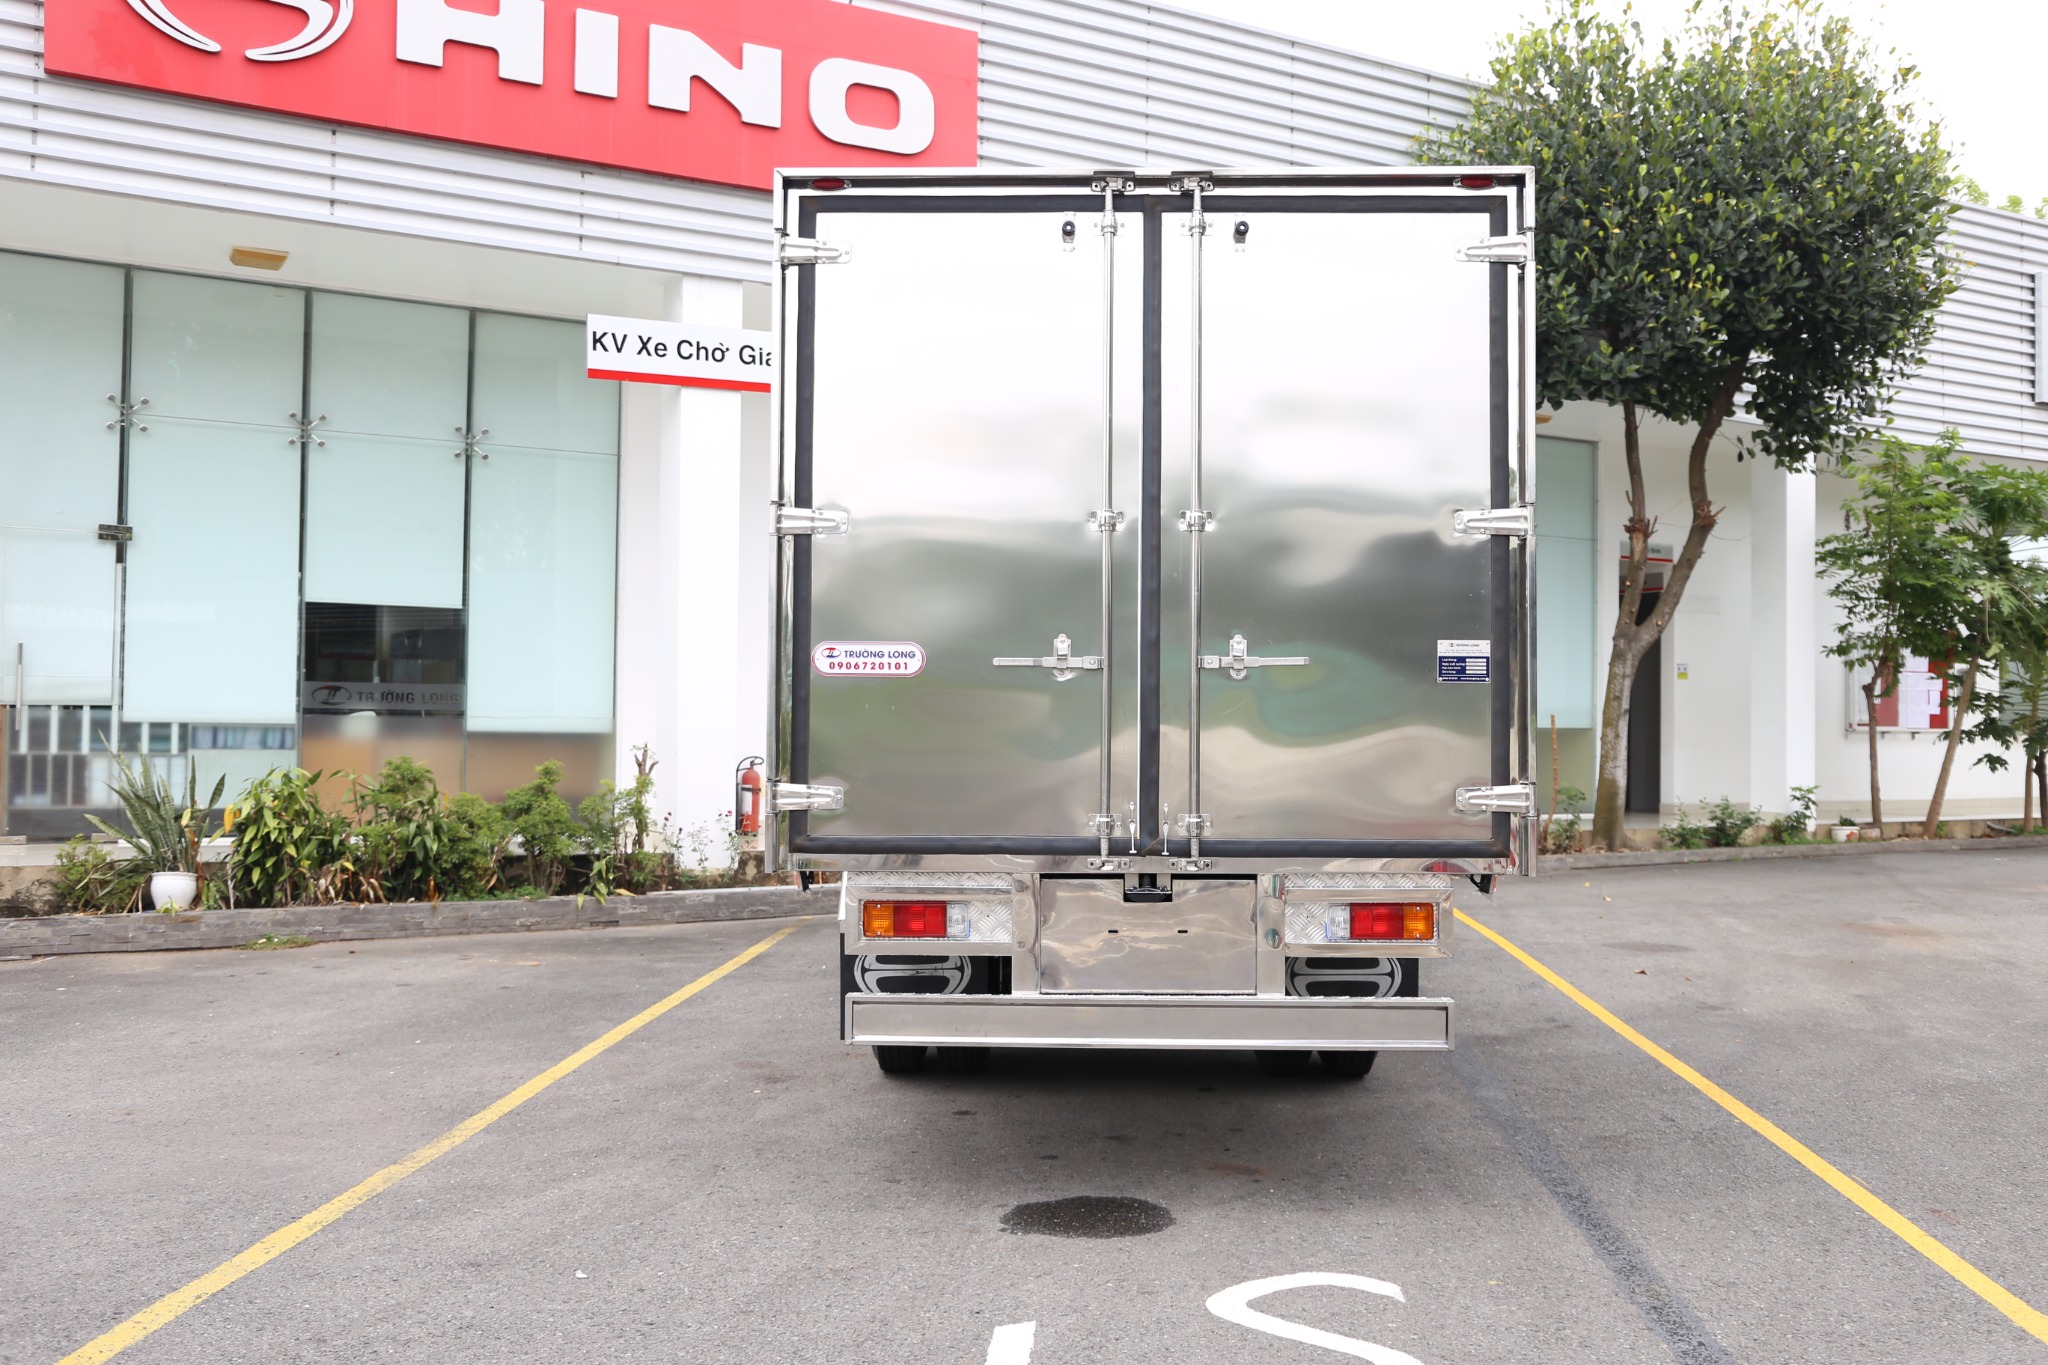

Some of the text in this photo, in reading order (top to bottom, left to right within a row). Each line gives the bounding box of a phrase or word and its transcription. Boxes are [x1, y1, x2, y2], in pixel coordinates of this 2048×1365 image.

[396, 0, 936, 155] HINO
[592, 331, 628, 353] KV
[636, 335, 668, 357] Xe
[676, 339, 730, 363] Chờ
[844, 649, 916, 659] TRƯỜNG LONG
[829, 662, 908, 670] 0906720101
[421, 692, 460, 704] LONG
